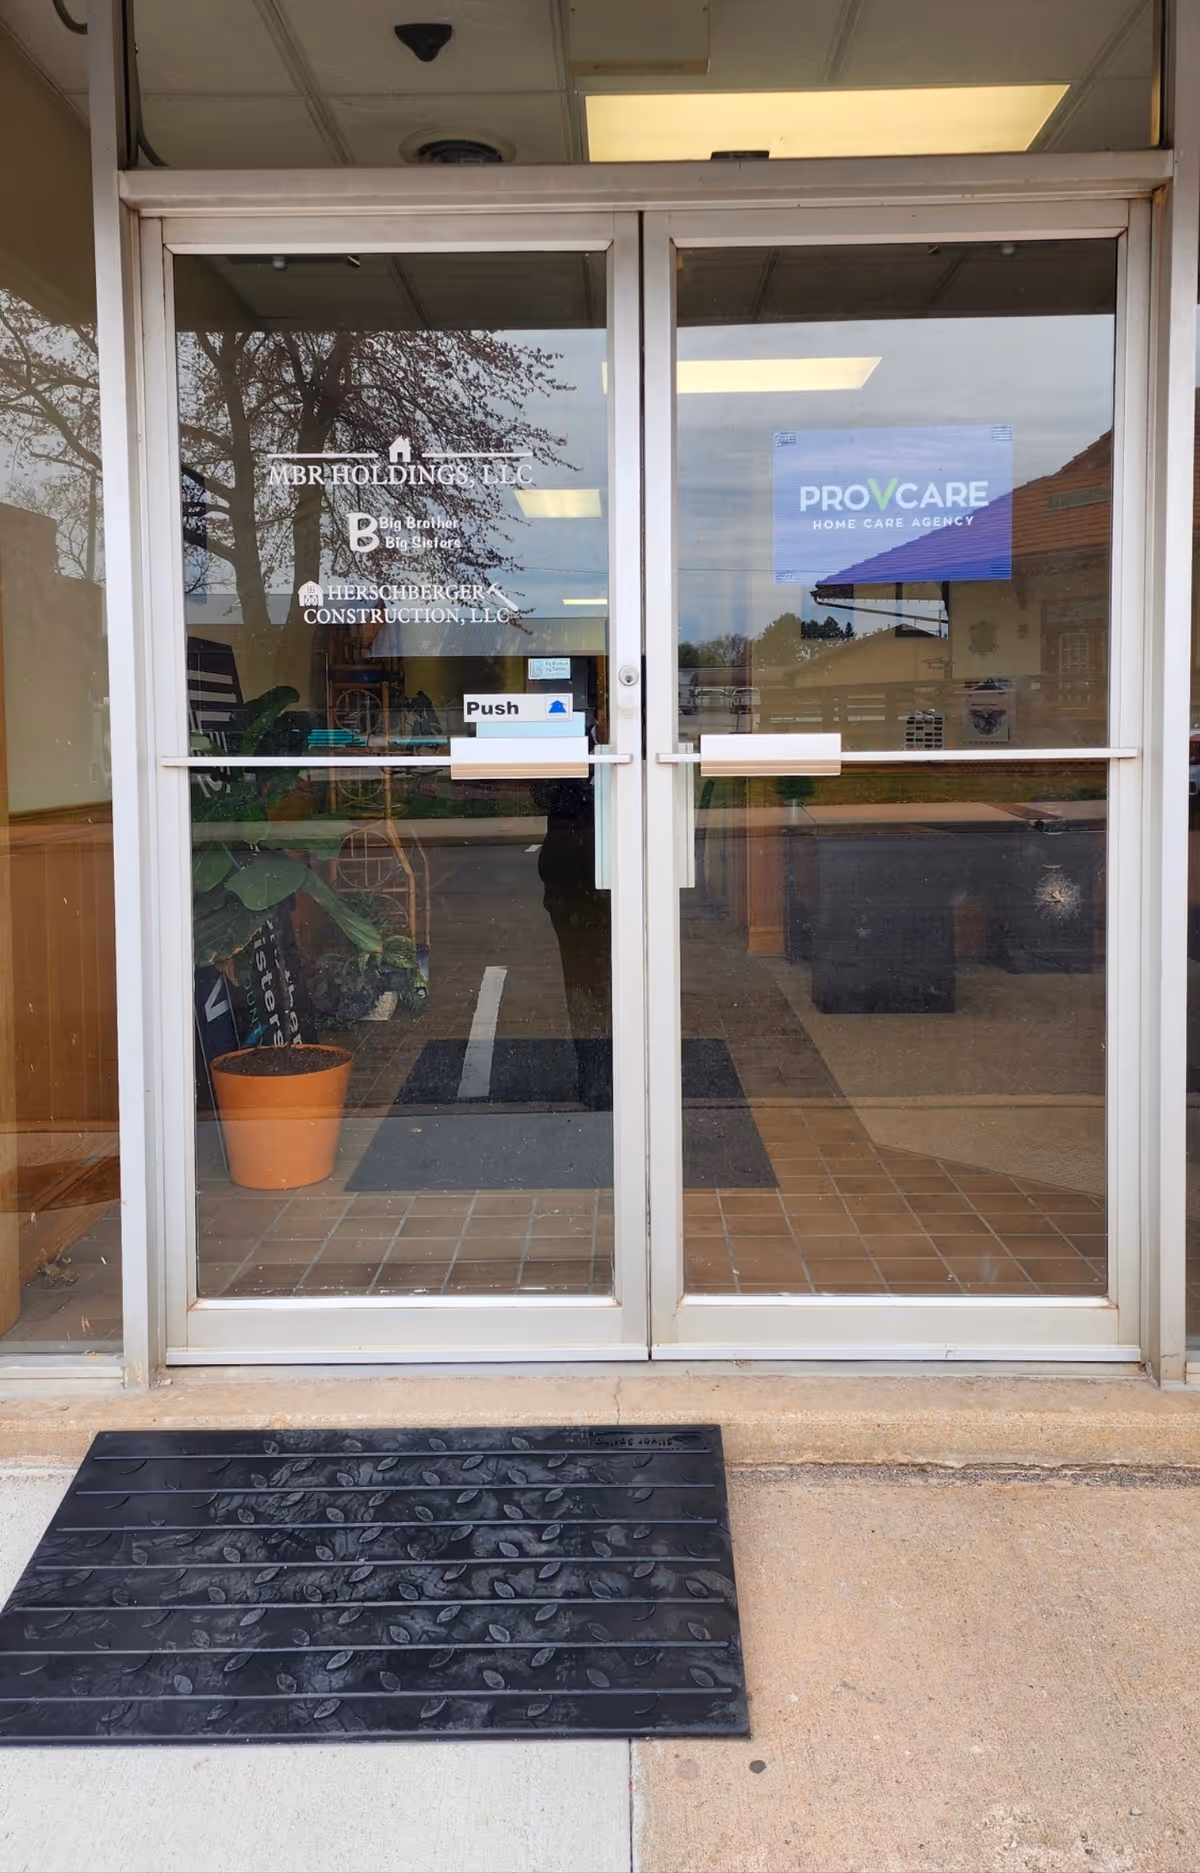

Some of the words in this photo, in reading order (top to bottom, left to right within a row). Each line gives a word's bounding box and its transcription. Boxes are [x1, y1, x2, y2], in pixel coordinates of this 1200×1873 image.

[267, 464, 325, 485] MBR
[331, 464, 475, 488] HOLDINGS,
[481, 464, 533, 485] LLC
[800, 476, 990, 512] PROVCARE
[379, 517, 401, 531] Big
[406, 515, 460, 529] Brother
[812, 518, 856, 531] HOME
[863, 516, 905, 530] CARE
[911, 515, 976, 528] AGENCY
[385, 536, 407, 550] Big
[411, 536, 461, 549] Sisters
[327, 583, 485, 601] HERSCHBERGER
[303, 607, 466, 626] CONSTRUCTION,
[470, 607, 510, 624] LLC
[466, 701, 520, 716] Push
